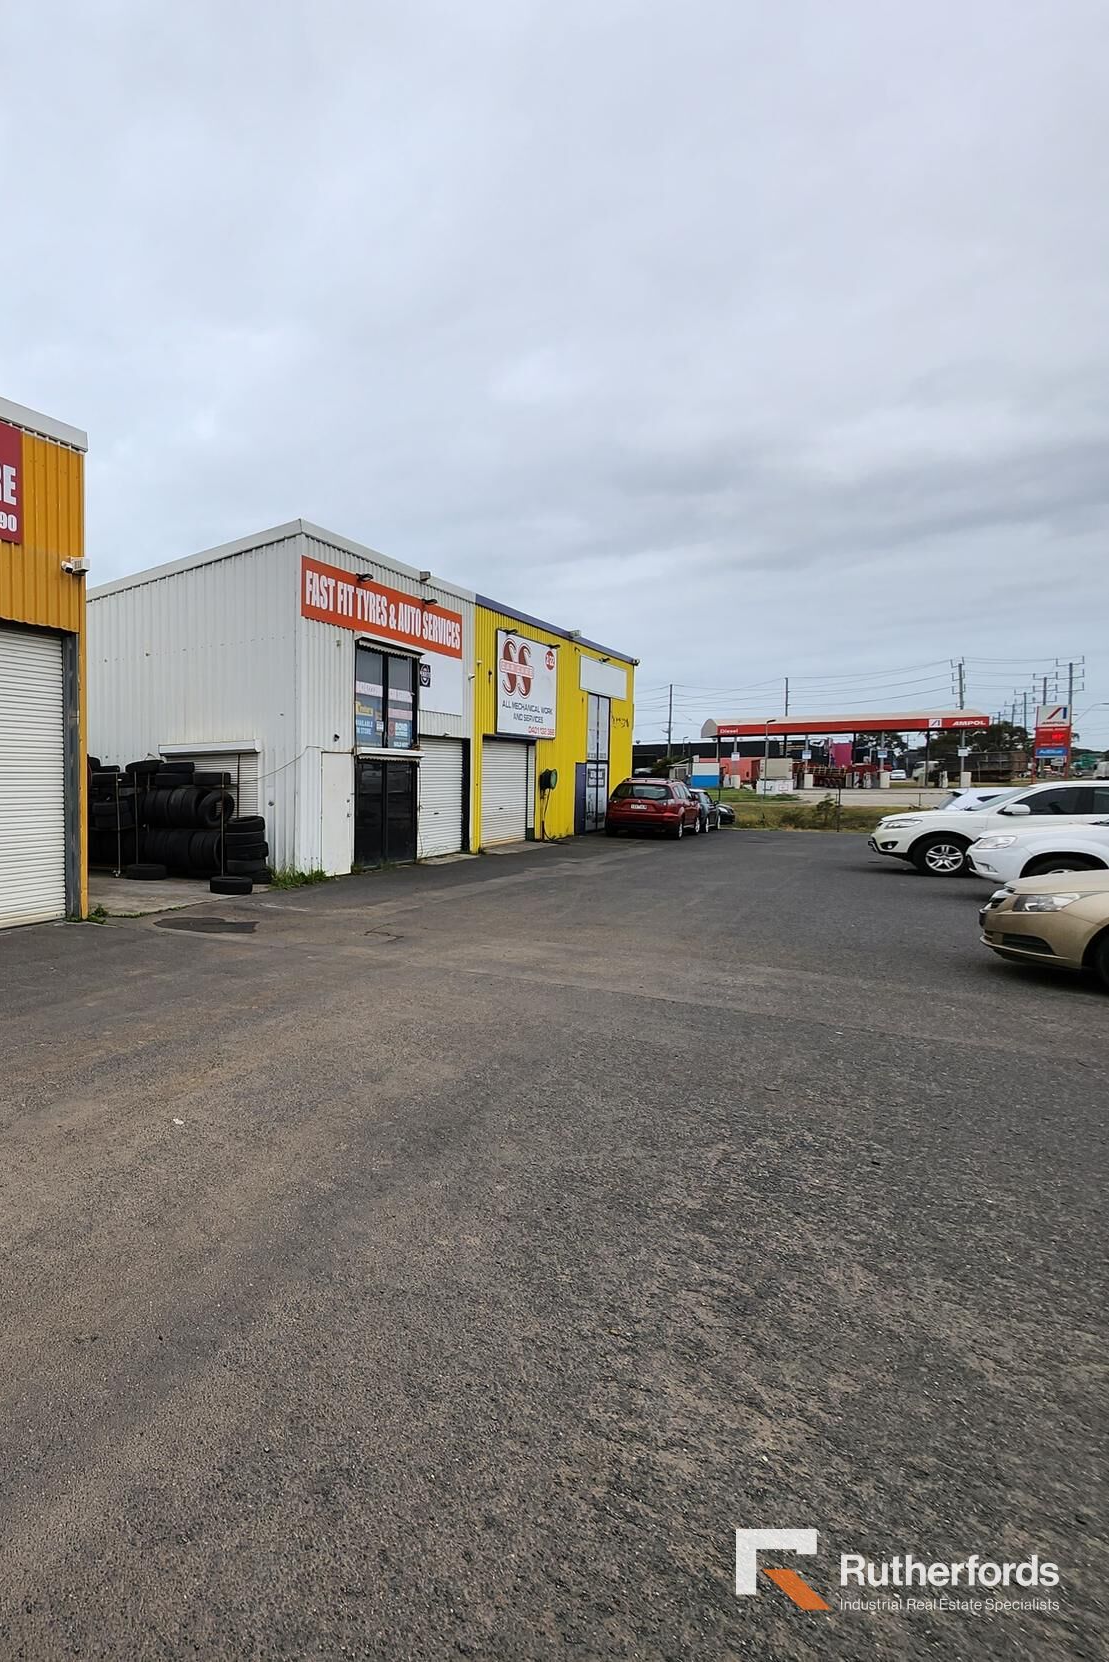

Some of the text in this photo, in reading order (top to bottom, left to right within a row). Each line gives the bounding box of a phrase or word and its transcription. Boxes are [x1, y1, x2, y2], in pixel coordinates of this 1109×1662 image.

[305, 570, 461, 650] FAST FIT TYRES & AUTO SERVICES
[502, 699, 553, 715] ALL MECHANICAL WORK
[513, 712, 544, 724] AND SERVICES
